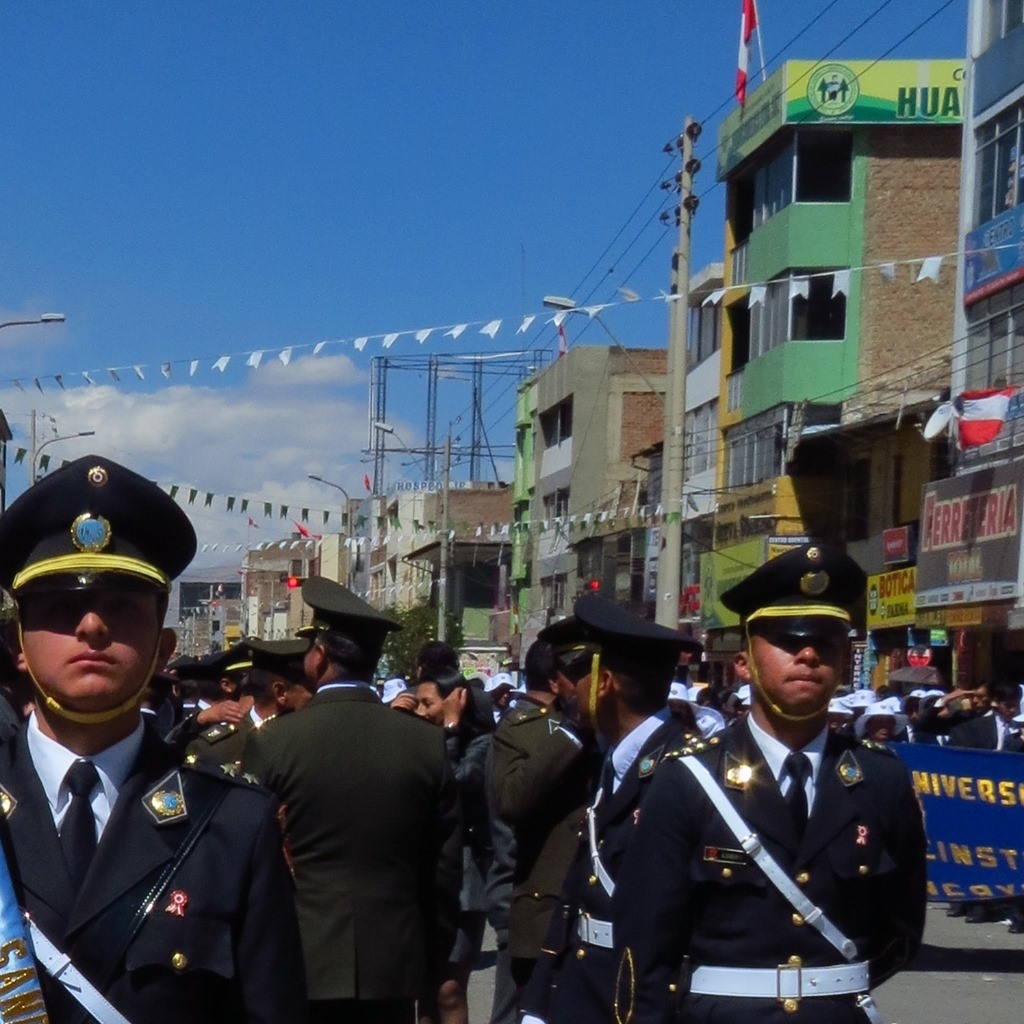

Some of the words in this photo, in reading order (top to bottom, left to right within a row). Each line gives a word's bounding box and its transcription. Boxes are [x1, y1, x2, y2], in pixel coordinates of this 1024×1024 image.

[397, 481, 466, 491] HOSPEDJE
[879, 570, 915, 598] BOTICA
[853, 648, 861, 690] INTERNE
[926, 840, 1024, 870] INST
